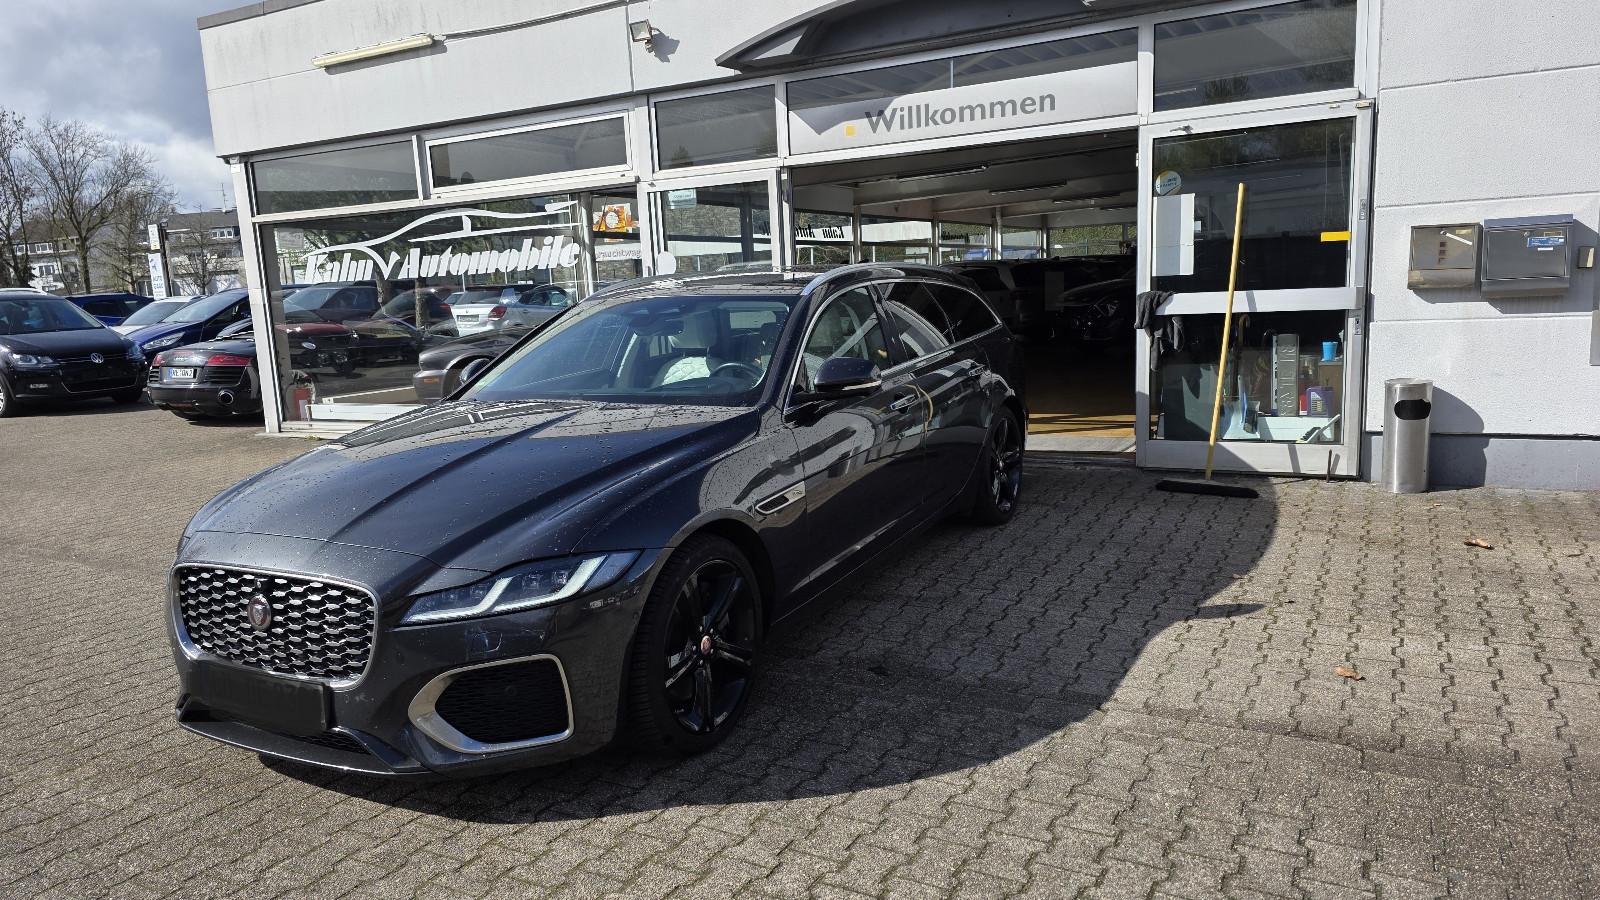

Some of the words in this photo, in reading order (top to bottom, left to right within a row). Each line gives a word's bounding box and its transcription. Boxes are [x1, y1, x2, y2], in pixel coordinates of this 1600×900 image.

[864, 93, 1056, 134] Willkommen
[303, 252, 374, 285] Kahn
[397, 235, 581, 279] Automobile
